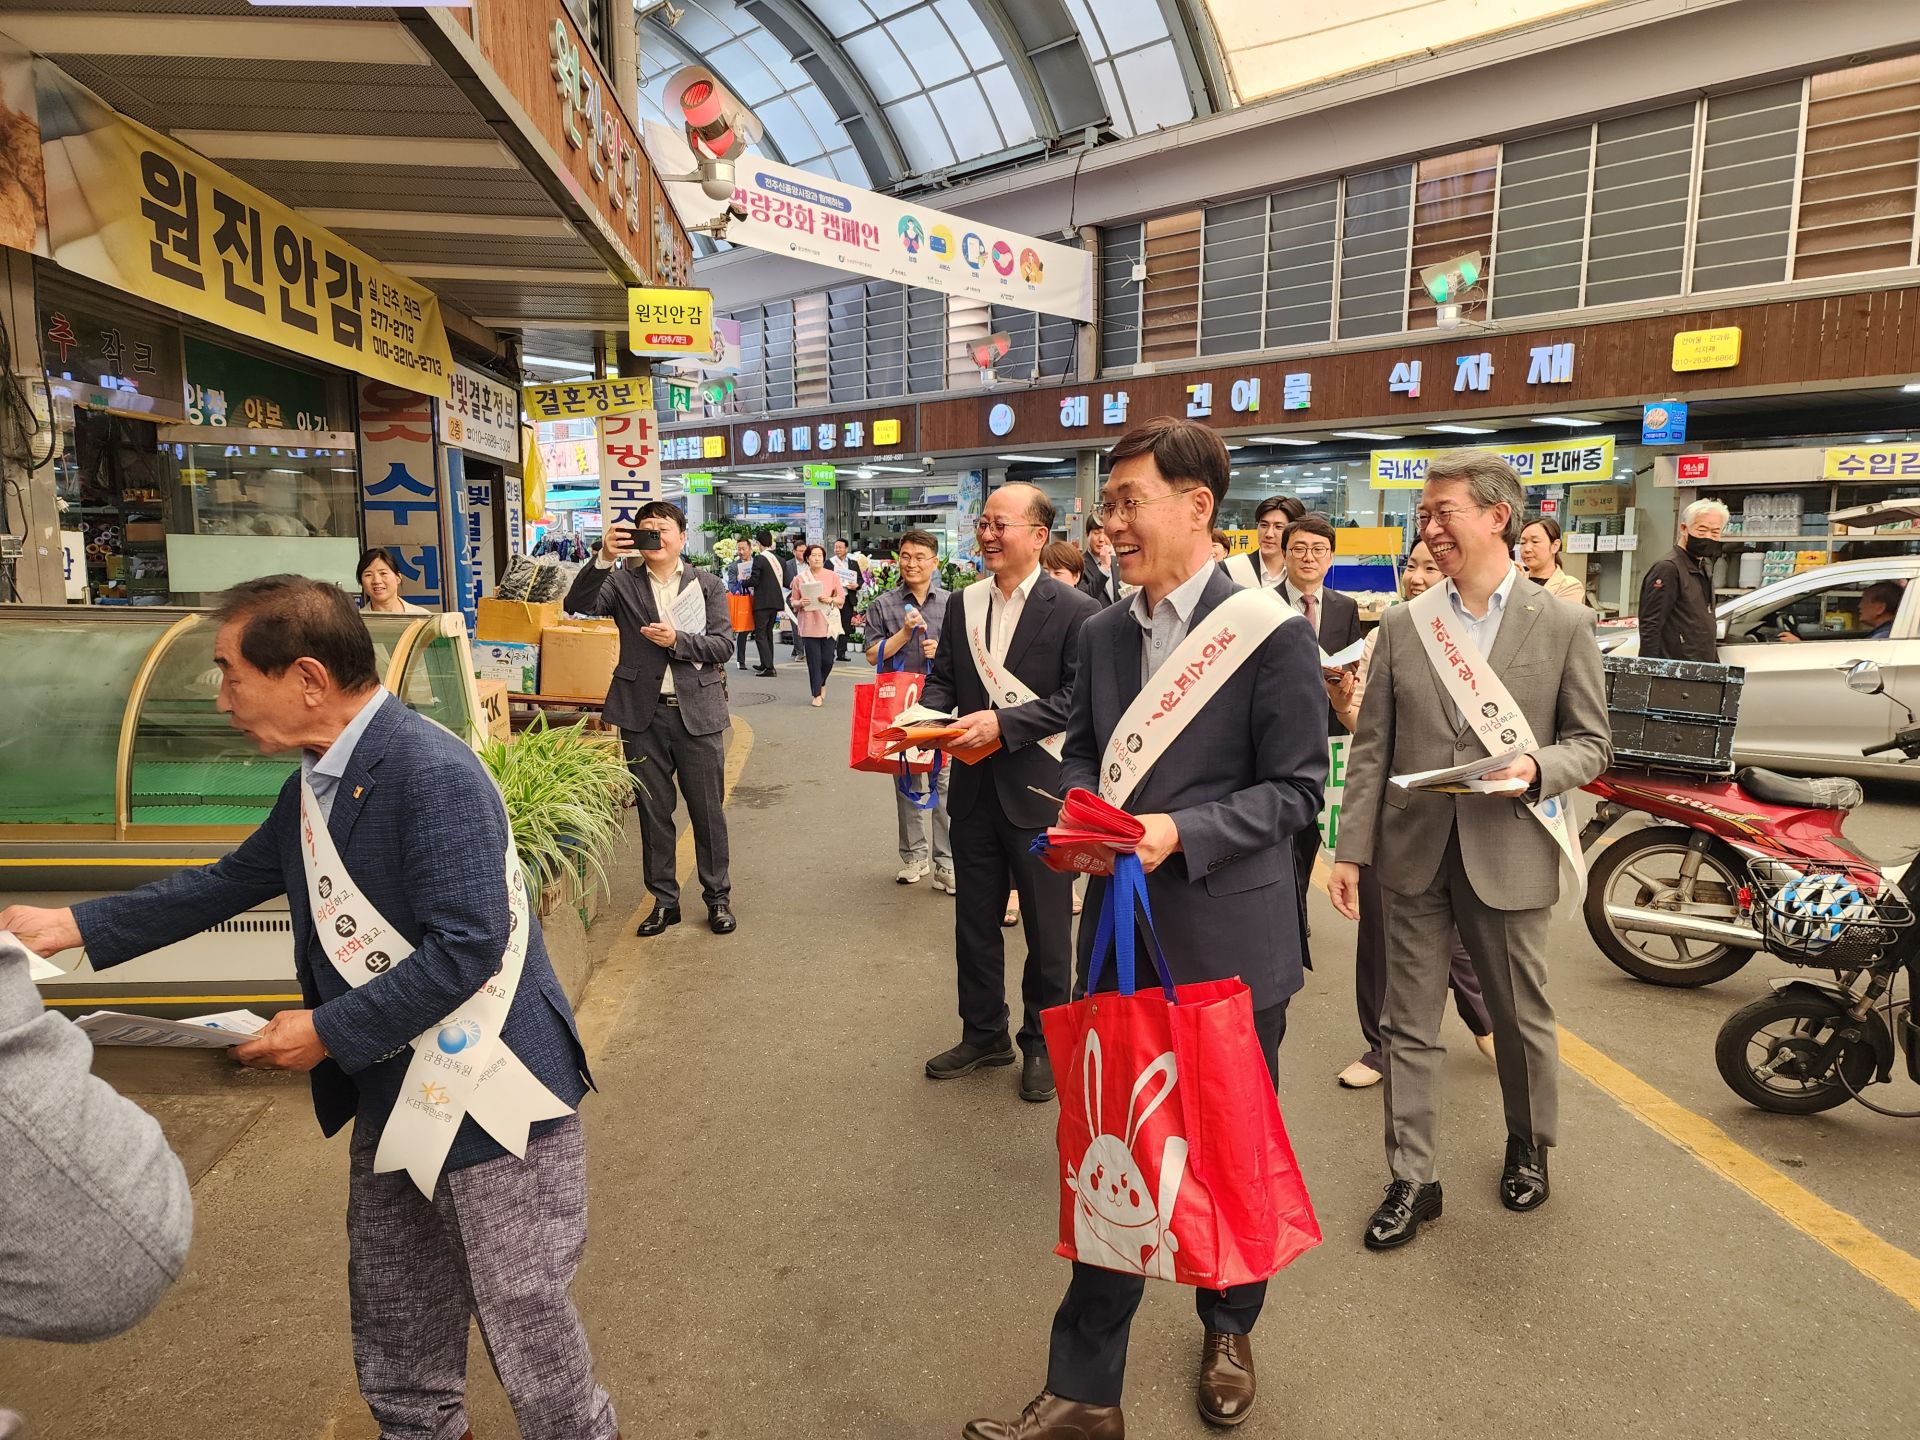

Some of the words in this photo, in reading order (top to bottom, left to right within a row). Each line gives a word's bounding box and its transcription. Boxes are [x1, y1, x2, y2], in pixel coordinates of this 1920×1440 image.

[549, 18, 641, 234] 원진안감
[821, 211, 881, 252] 캠페인
[138, 150, 365, 352] 원진안감
[403, 295, 422, 322] 작크
[635, 303, 703, 325] 원진안감
[370, 308, 414, 344] 277-2713
[372, 335, 443, 377] 010-3210-2713
[1060, 391, 1129, 427] 해남
[1186, 373, 1312, 418] 건어물
[1388, 343, 1576, 397] 식자재
[449, 417, 463, 441] 2층
[1378, 458, 1428, 480] 국내산
[1541, 447, 1602, 475] 판매중
[1430, 616, 1480, 696] 보이스피싱!
[1145, 627, 1237, 727] 보이스피싱!
[1480, 711, 1518, 735] 의심하고,
[1112, 738, 1137, 777] 의심하고,
[1127, 733, 1143, 753] 늘
[319, 875, 333, 899] 늘
[316, 889, 355, 924] 의심하고,
[335, 914, 357, 938] 꼭
[335, 926, 386, 964] 전화끊고,
[365, 951, 391, 974] 또
[423, 1049, 473, 1078] 금융감독원
[405, 1096, 453, 1123] KB국민은행
